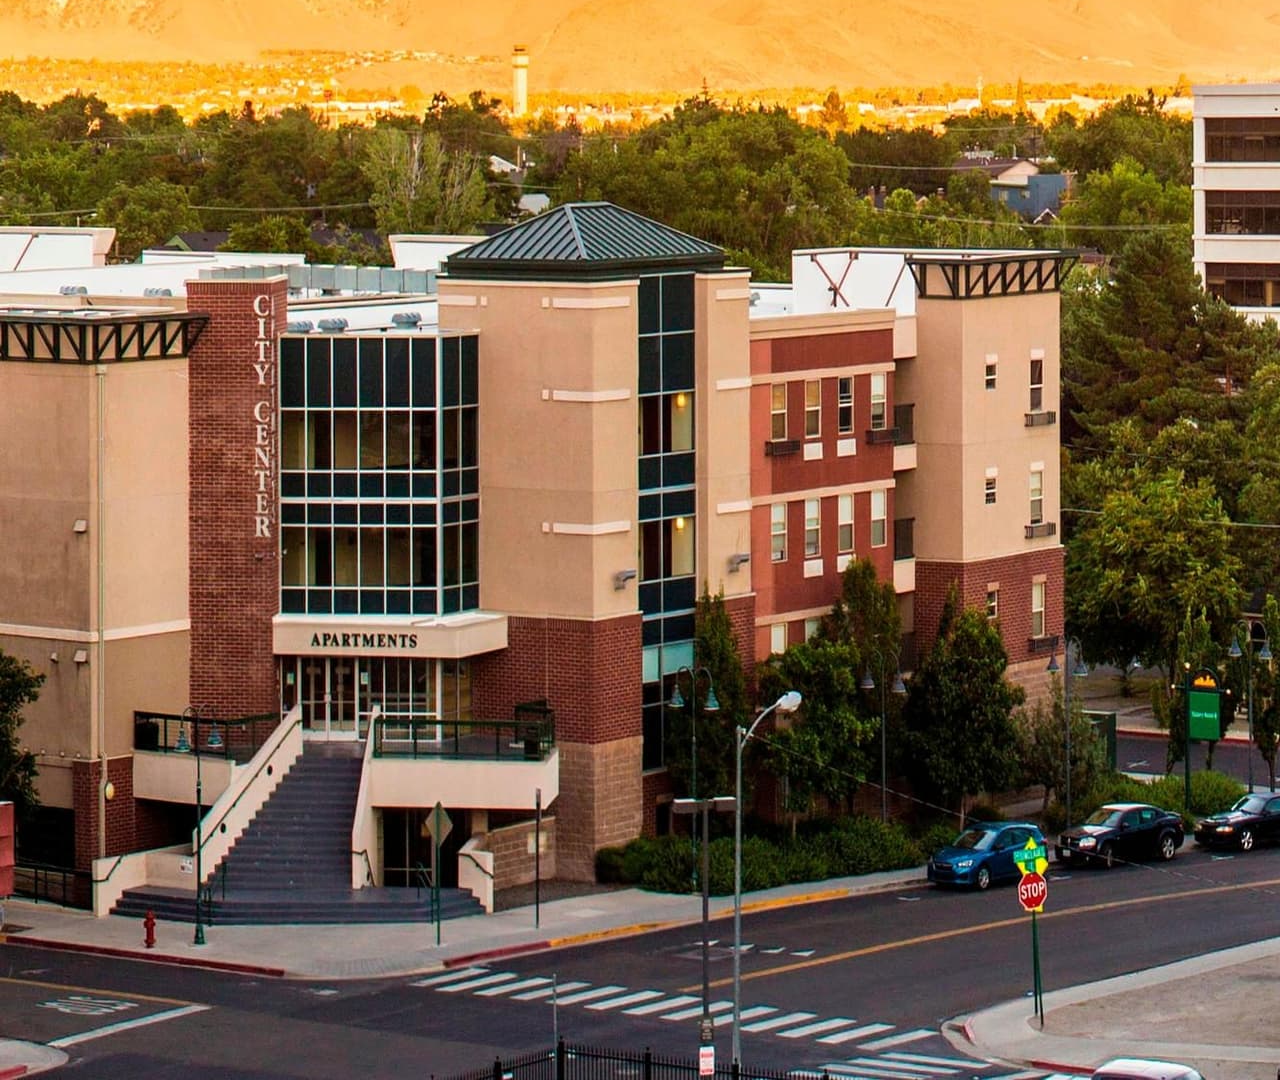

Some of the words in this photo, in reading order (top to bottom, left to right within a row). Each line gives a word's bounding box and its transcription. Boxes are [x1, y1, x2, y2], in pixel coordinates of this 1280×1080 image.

[253, 295, 270, 386] CITY
[254, 401, 271, 537] CENTER
[311, 632, 418, 648] APARTMENTS
[1021, 881, 1045, 900] STOP
